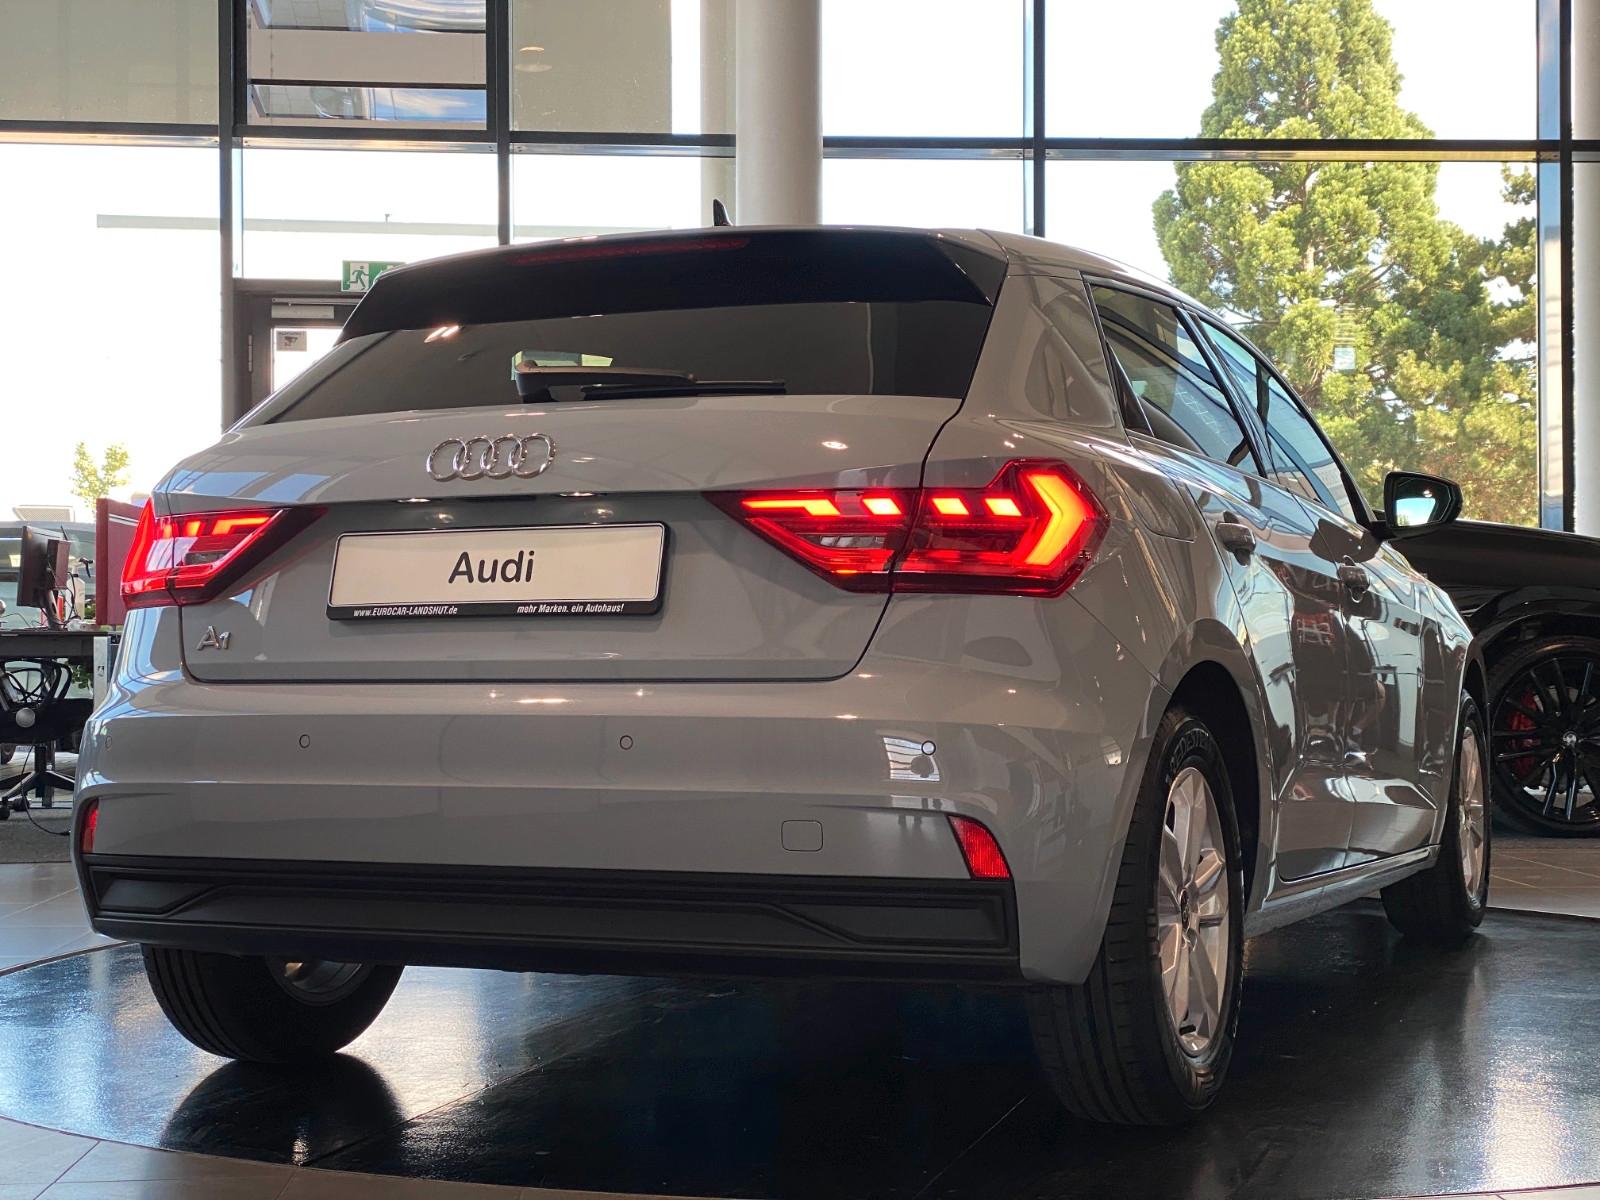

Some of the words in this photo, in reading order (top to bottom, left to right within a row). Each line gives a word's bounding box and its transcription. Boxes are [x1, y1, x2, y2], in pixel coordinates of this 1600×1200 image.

[448, 550, 535, 584] Audi
[353, 605, 458, 617] www.EUROCAR-LANDSHUT.de
[571, 603, 584, 613] ein
[584, 603, 625, 613] Autohaus!
[196, 625, 231, 651] A1
